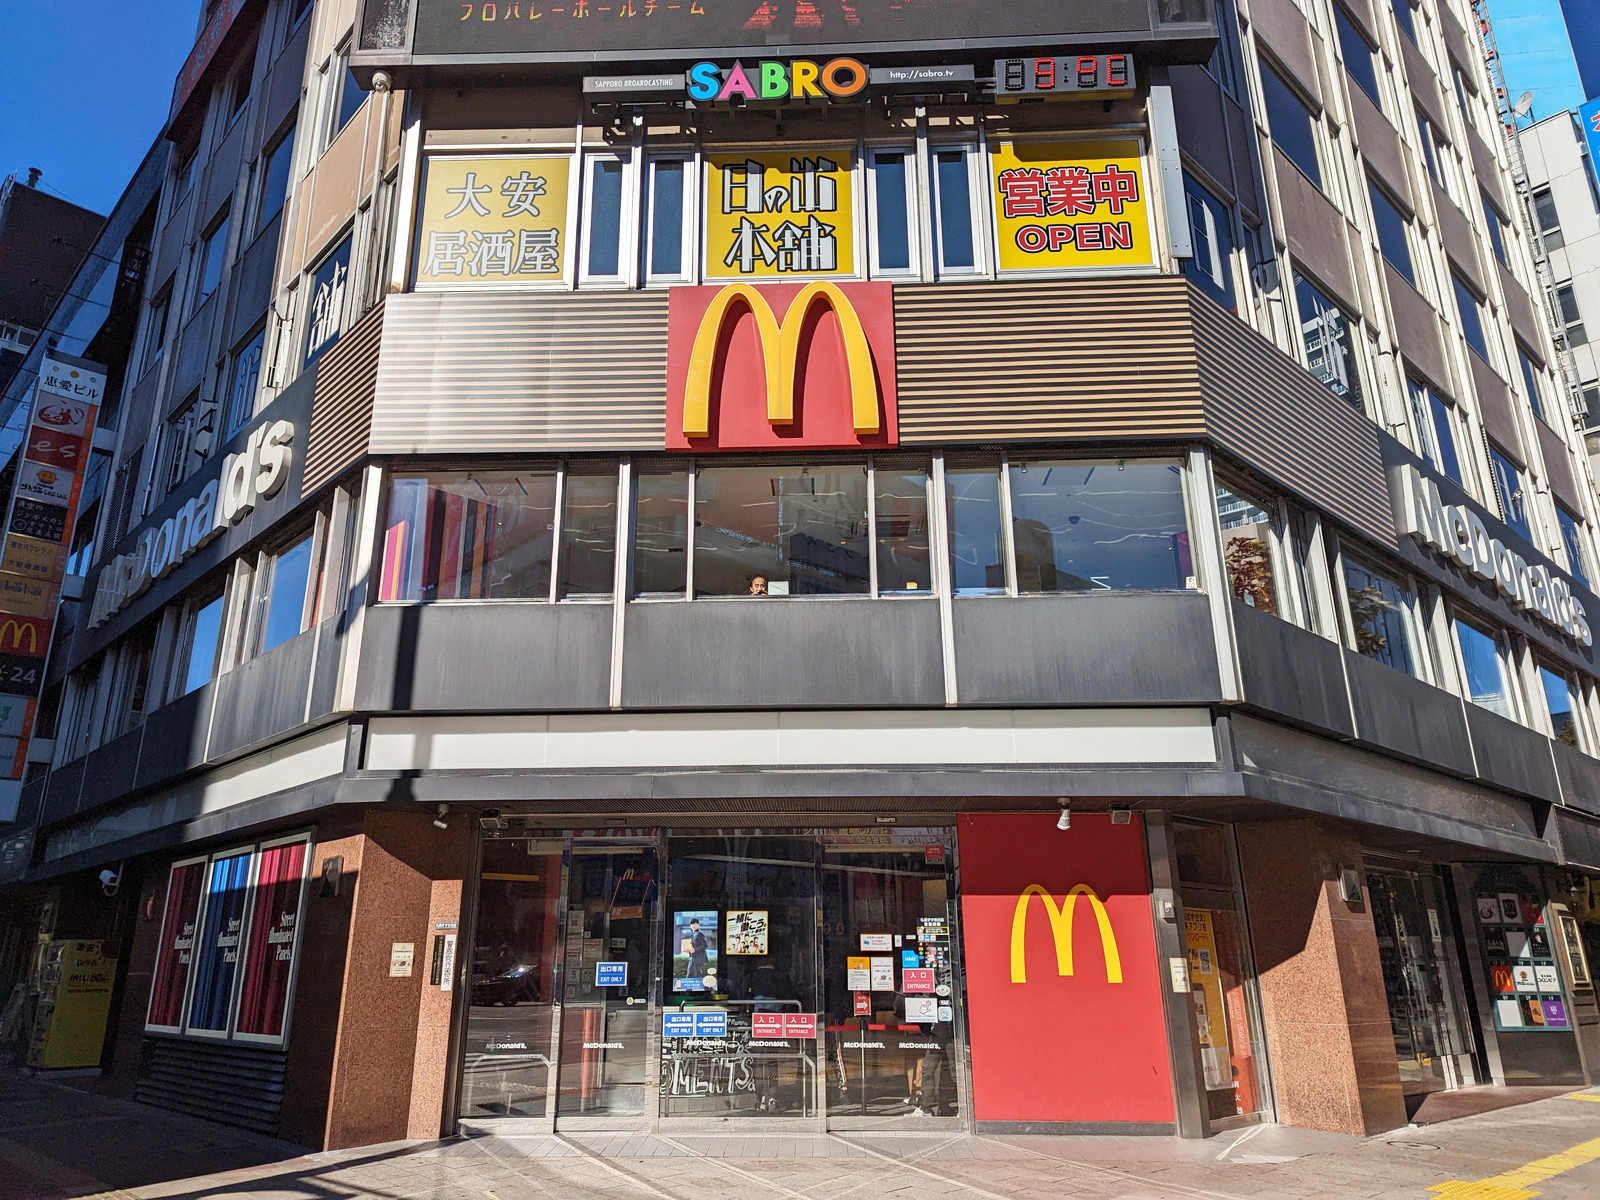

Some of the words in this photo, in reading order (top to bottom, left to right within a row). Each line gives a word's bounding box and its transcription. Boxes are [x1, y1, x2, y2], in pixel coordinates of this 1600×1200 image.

[595, 80, 623, 88] SAPPORO
[624, 78, 673, 87] BROARDCASTING
[688, 58, 868, 101] SABRO
[890, 69, 954, 80] http://sabro.tv
[444, 171, 547, 219] 大安
[1000, 164, 1138, 219] 営業中
[1015, 222, 1132, 252] OPEN
[422, 227, 560, 277] 居酒屋
[29, 440, 76, 458] es
[1401, 463, 1593, 648] McDonald's
[10, 666, 36, 684] 24
[280, 910, 295, 927] Street
[728, 912, 753, 923] 一緒に
[276, 944, 292, 961] Panels
[910, 971, 927, 979] 入口
[790, 1016, 807, 1024] 入口
[748, 1040, 790, 1048] McDonald's
[843, 1041, 886, 1049] McDonald's
